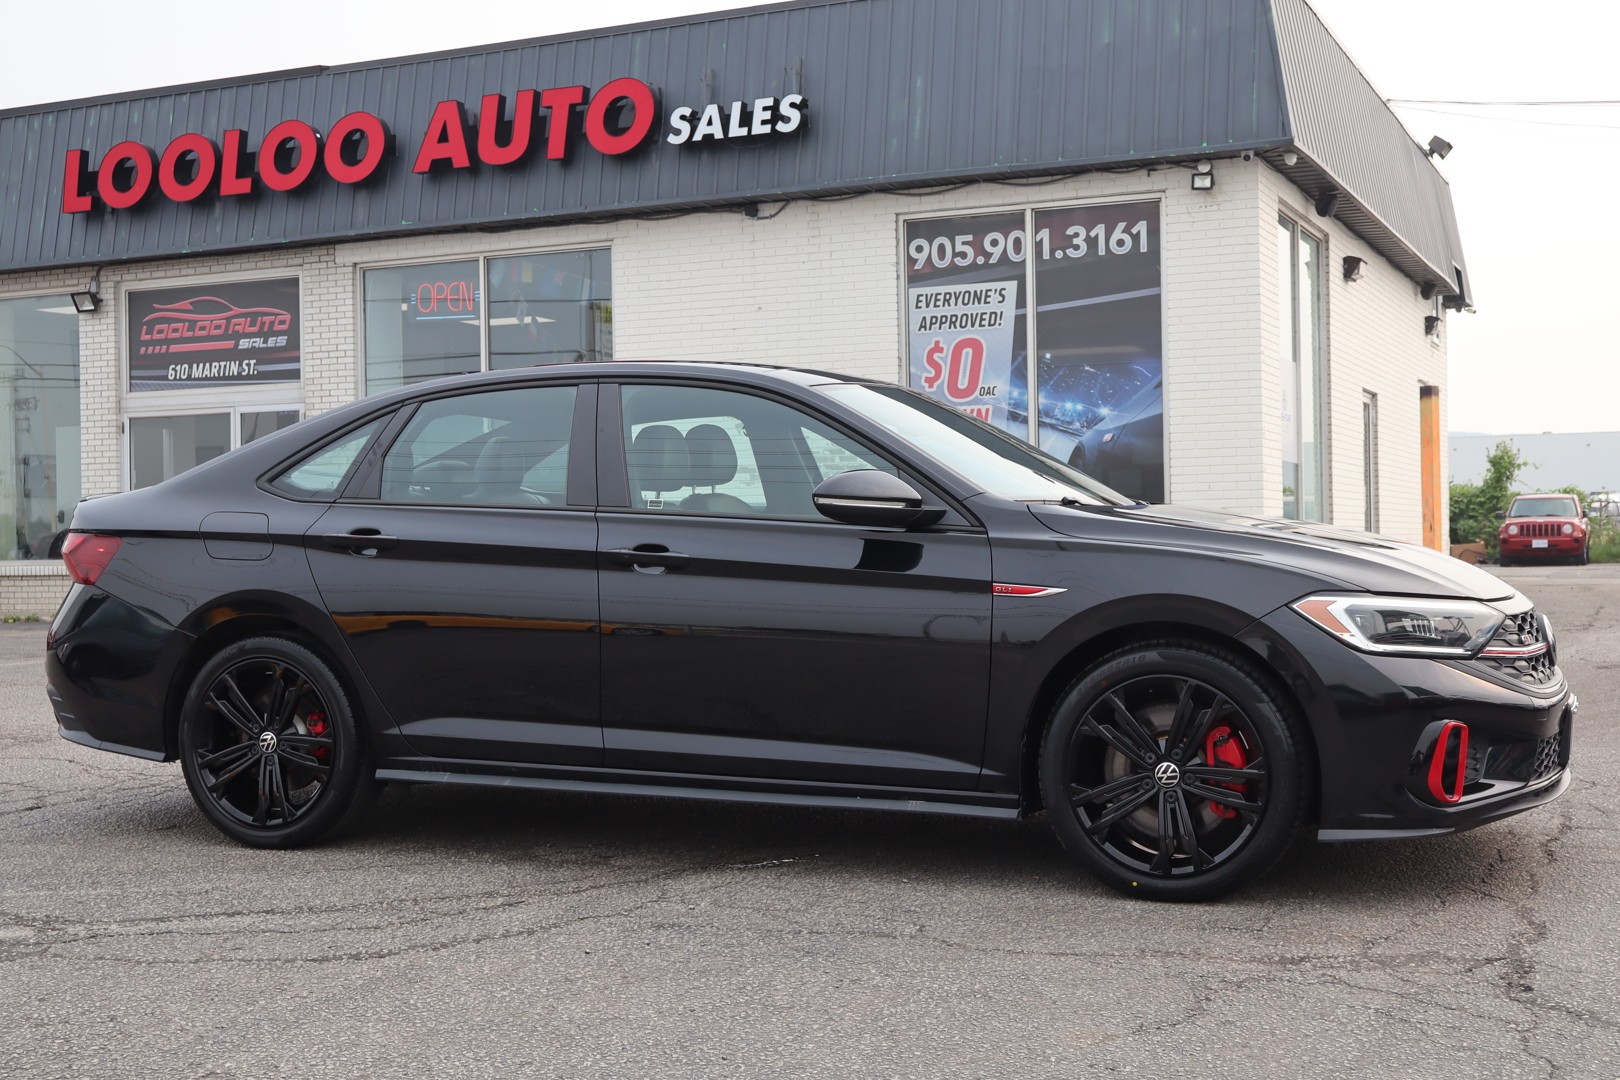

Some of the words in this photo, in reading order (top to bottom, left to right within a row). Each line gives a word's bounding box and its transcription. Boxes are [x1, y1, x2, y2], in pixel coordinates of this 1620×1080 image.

[62, 111, 386, 213] LOOLOO
[411, 77, 655, 173] AUTO
[666, 93, 804, 145] SALES
[908, 220, 1148, 270] 905.901.3161
[417, 281, 474, 313] OPEN
[914, 287, 1007, 310] EVERYONE'S
[140, 319, 227, 341] LOOLOO
[228, 314, 292, 335] AUTO
[917, 311, 1004, 332] APPROVED!
[238, 336, 288, 349] SALES
[167, 363, 189, 380] 610
[191, 360, 239, 379] MARTIN
[241, 359, 258, 376] ST.
[923, 337, 984, 399] $0
[979, 386, 997, 397] OAC
